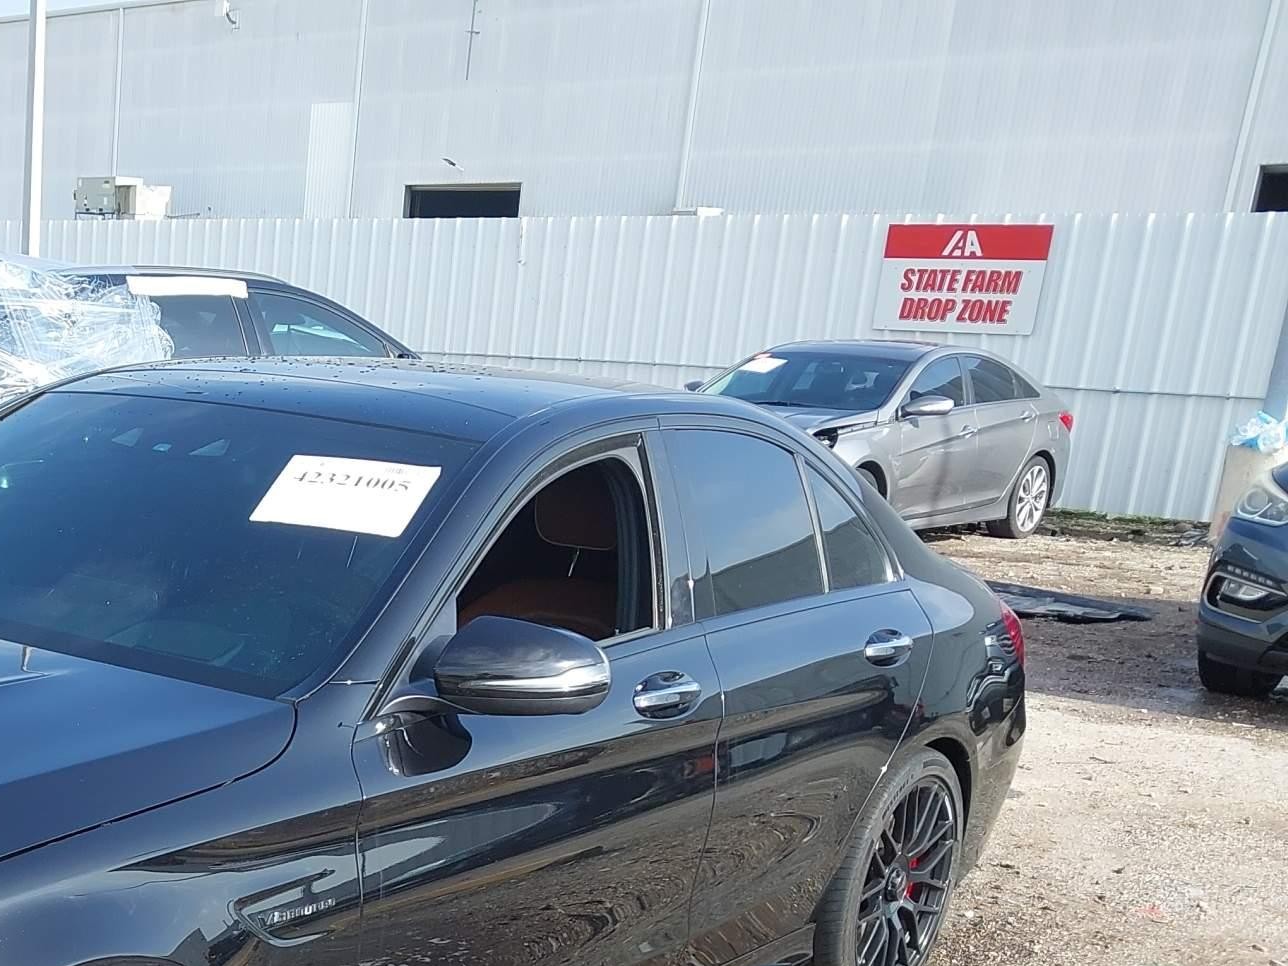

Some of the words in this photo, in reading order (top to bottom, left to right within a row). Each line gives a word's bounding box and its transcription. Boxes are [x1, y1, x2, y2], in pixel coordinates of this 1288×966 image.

[900, 268, 960, 293] STATE
[962, 270, 1023, 295] FARM
[898, 297, 957, 321] DROP
[956, 299, 1013, 324] ZONE
[293, 471, 411, 492] 42321005
